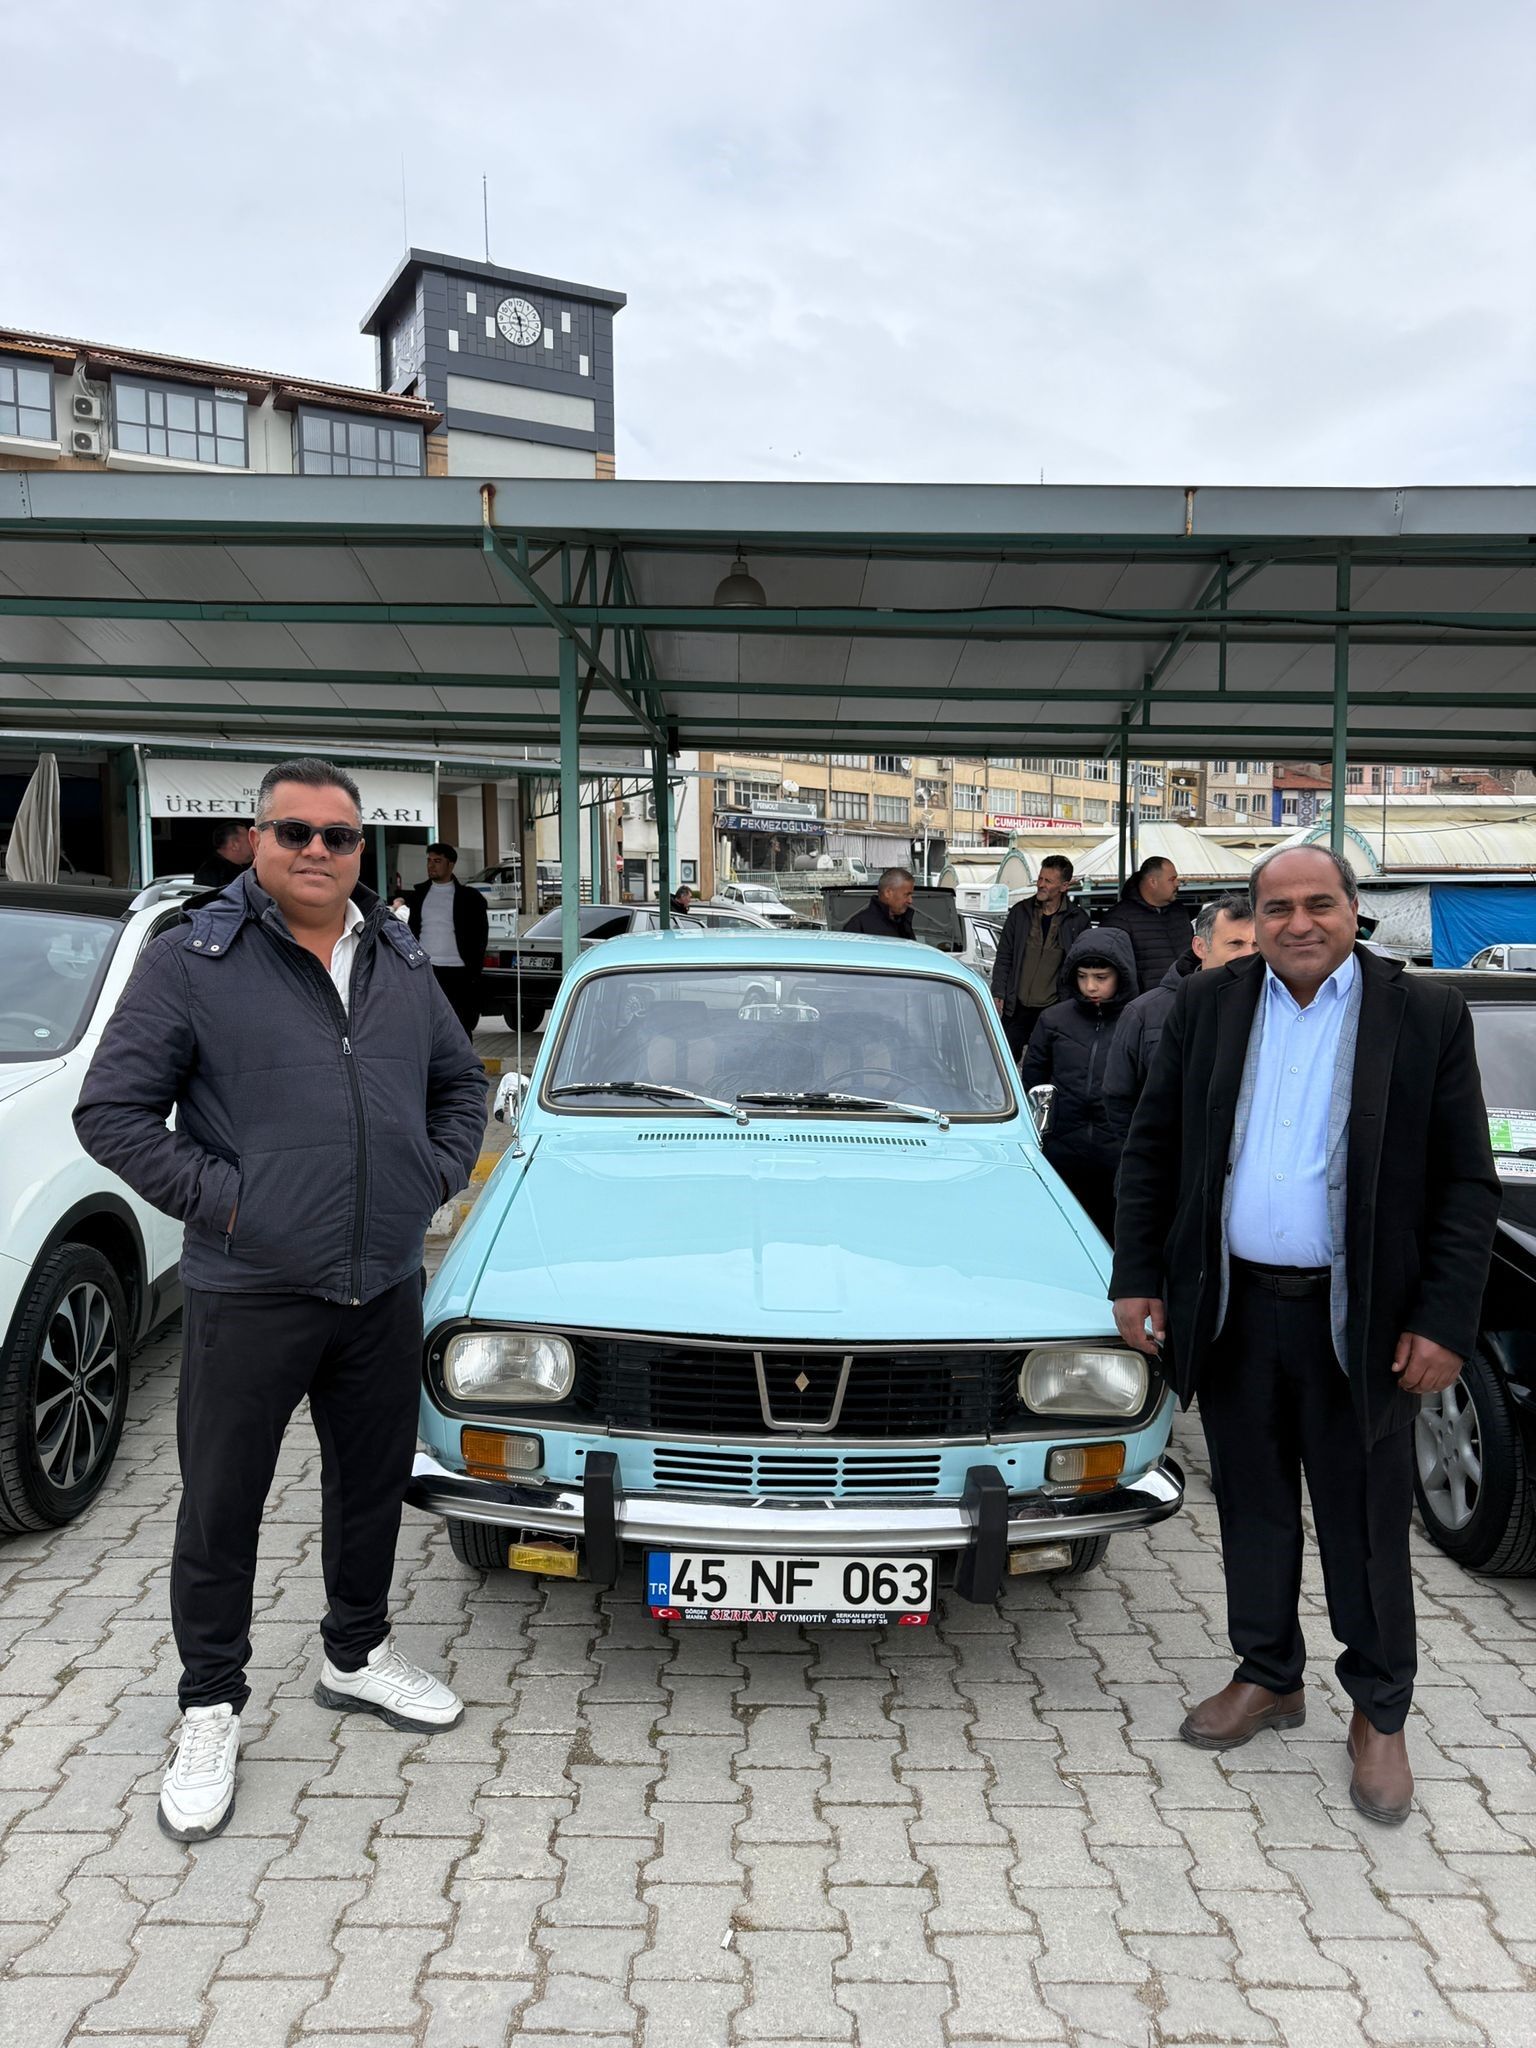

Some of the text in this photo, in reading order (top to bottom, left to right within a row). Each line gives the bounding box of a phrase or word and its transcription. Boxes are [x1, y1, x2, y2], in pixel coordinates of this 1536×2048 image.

[165, 795, 422, 822] ÜRETİ ARI
[650, 1583, 667, 1596] TR
[672, 1559, 928, 1605] 45 NF 063
[710, 1609, 828, 1623] SERKAN OTOMOTİV
